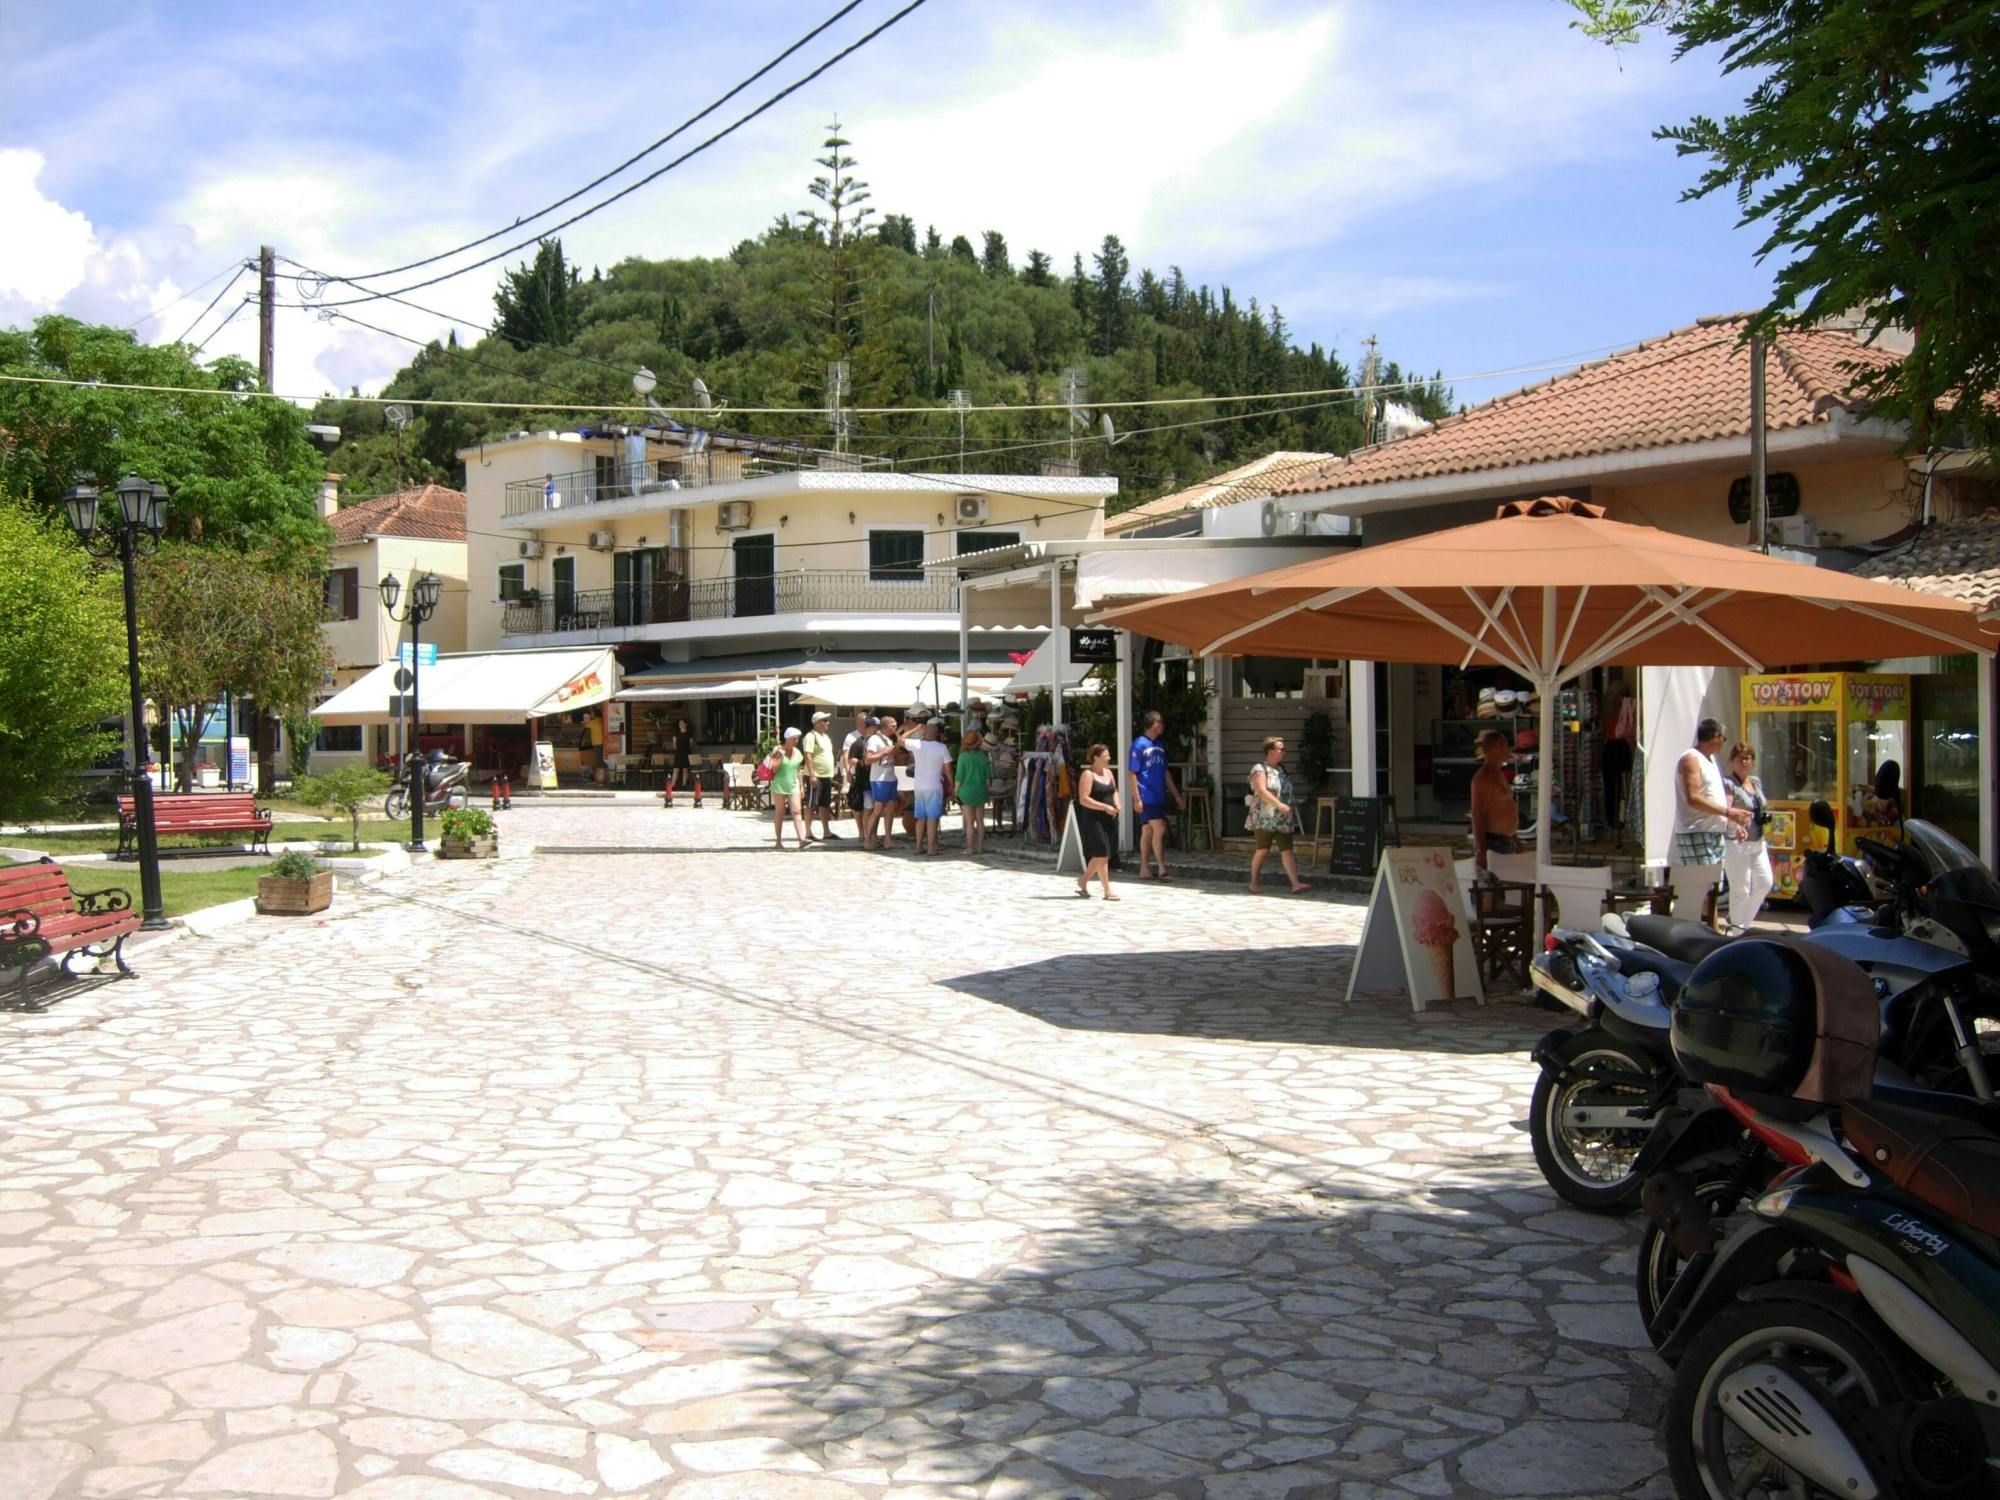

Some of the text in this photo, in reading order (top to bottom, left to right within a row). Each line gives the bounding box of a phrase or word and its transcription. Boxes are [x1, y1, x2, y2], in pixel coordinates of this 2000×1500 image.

[1752, 681, 1832, 699] TOY STORY
[1850, 683, 1905, 699] TOY STORY
[1881, 1213, 1949, 1256] Liberty
